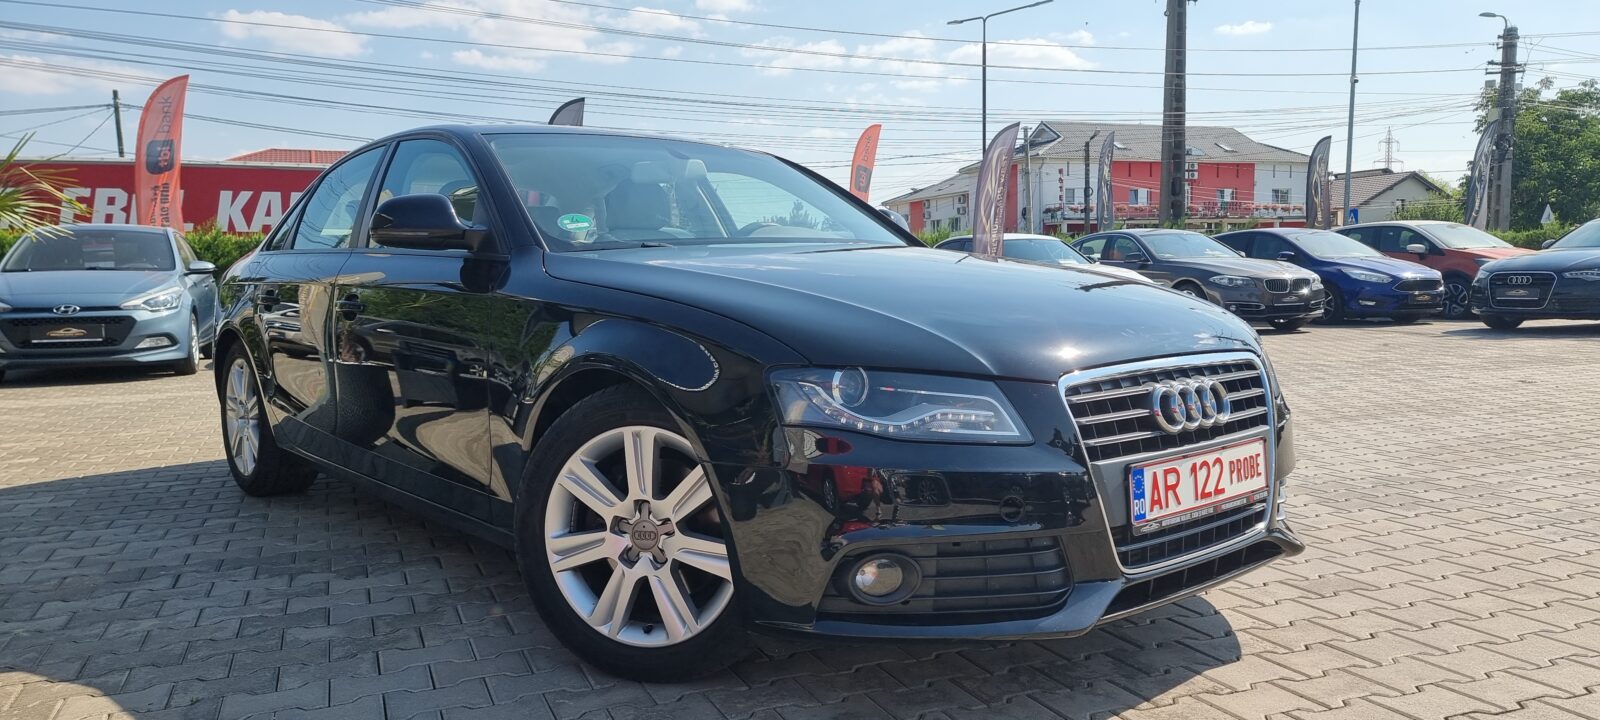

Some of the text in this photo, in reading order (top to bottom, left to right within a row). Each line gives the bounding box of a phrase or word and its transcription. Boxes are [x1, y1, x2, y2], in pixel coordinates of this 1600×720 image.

[157, 95, 172, 167] tbi bank
[1134, 498, 1146, 514] RO
[1149, 453, 1262, 513] AR 122 PROBE
